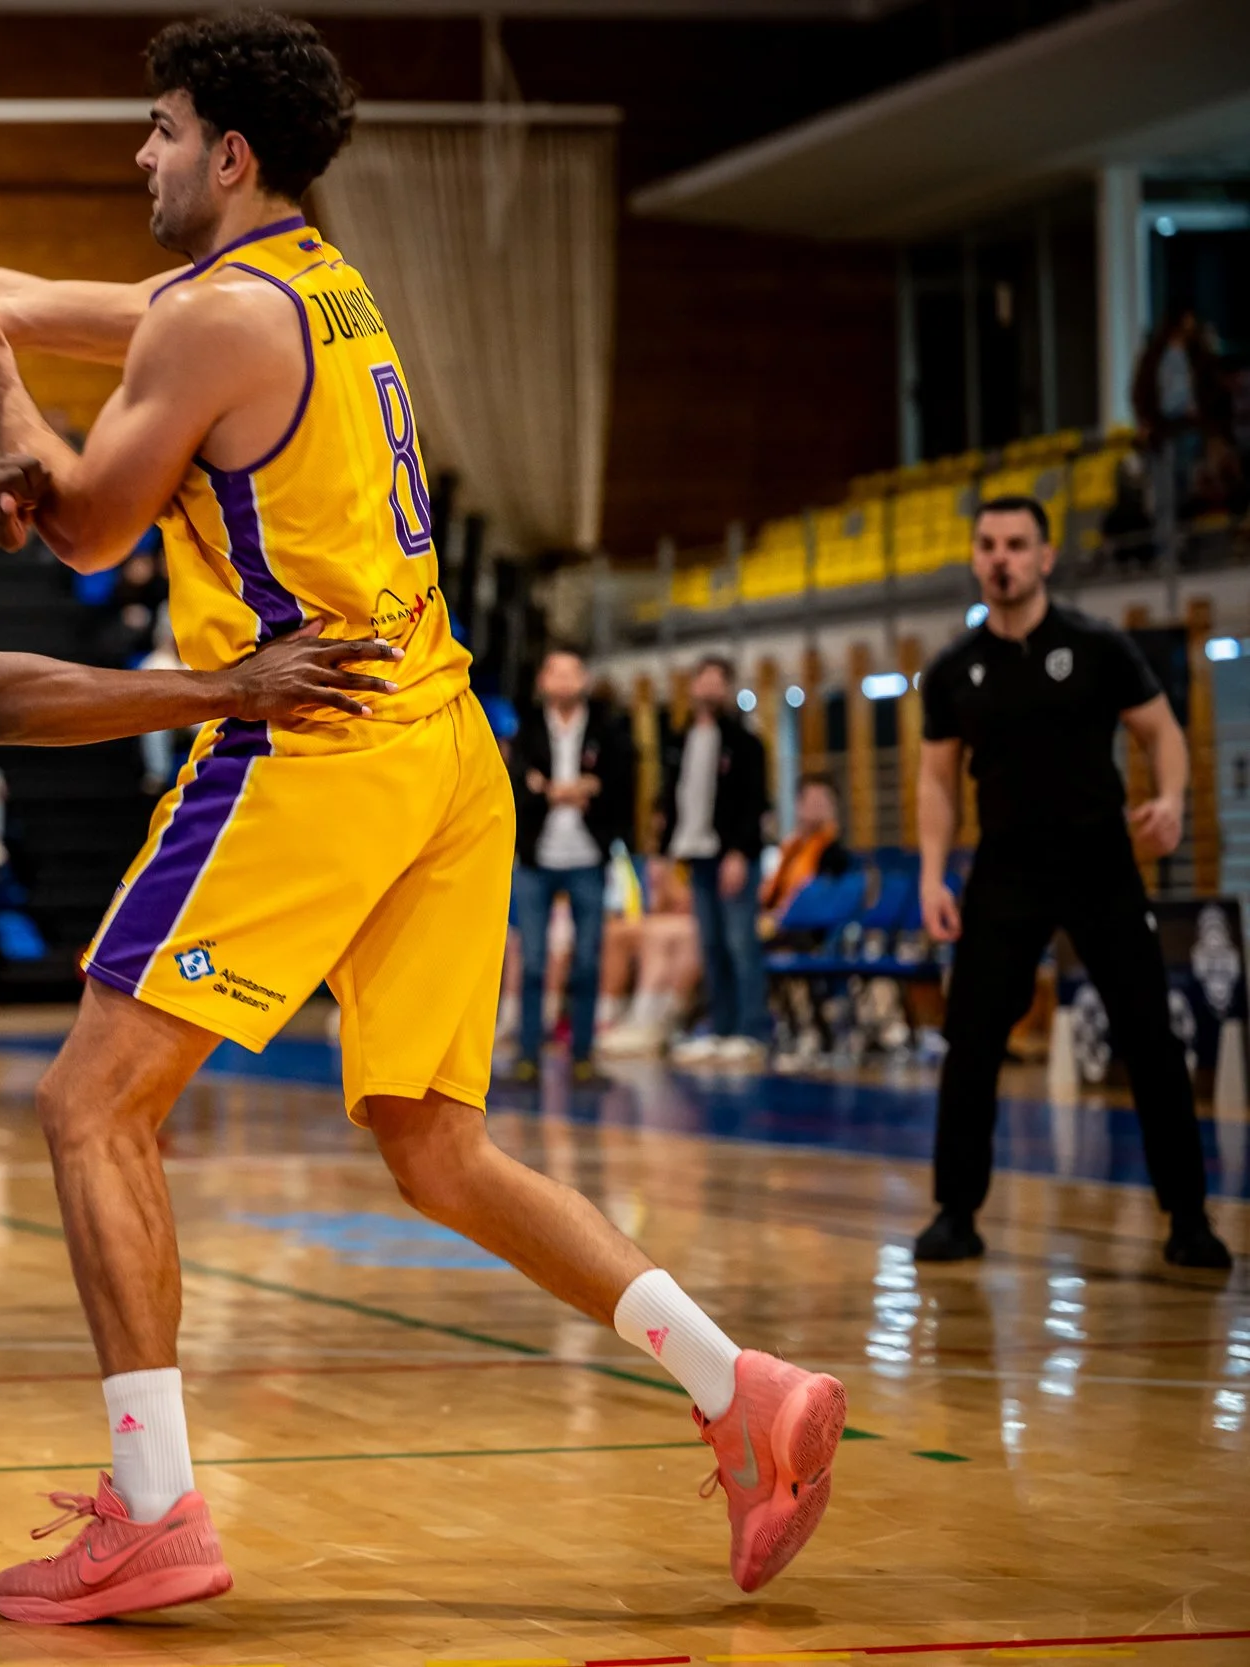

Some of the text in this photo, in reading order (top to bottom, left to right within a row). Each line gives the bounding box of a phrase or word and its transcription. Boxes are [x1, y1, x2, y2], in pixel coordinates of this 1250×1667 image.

[370, 361, 431, 558] 8
[213, 983, 228, 995] de
[220, 967, 287, 1004] Ajuntament
